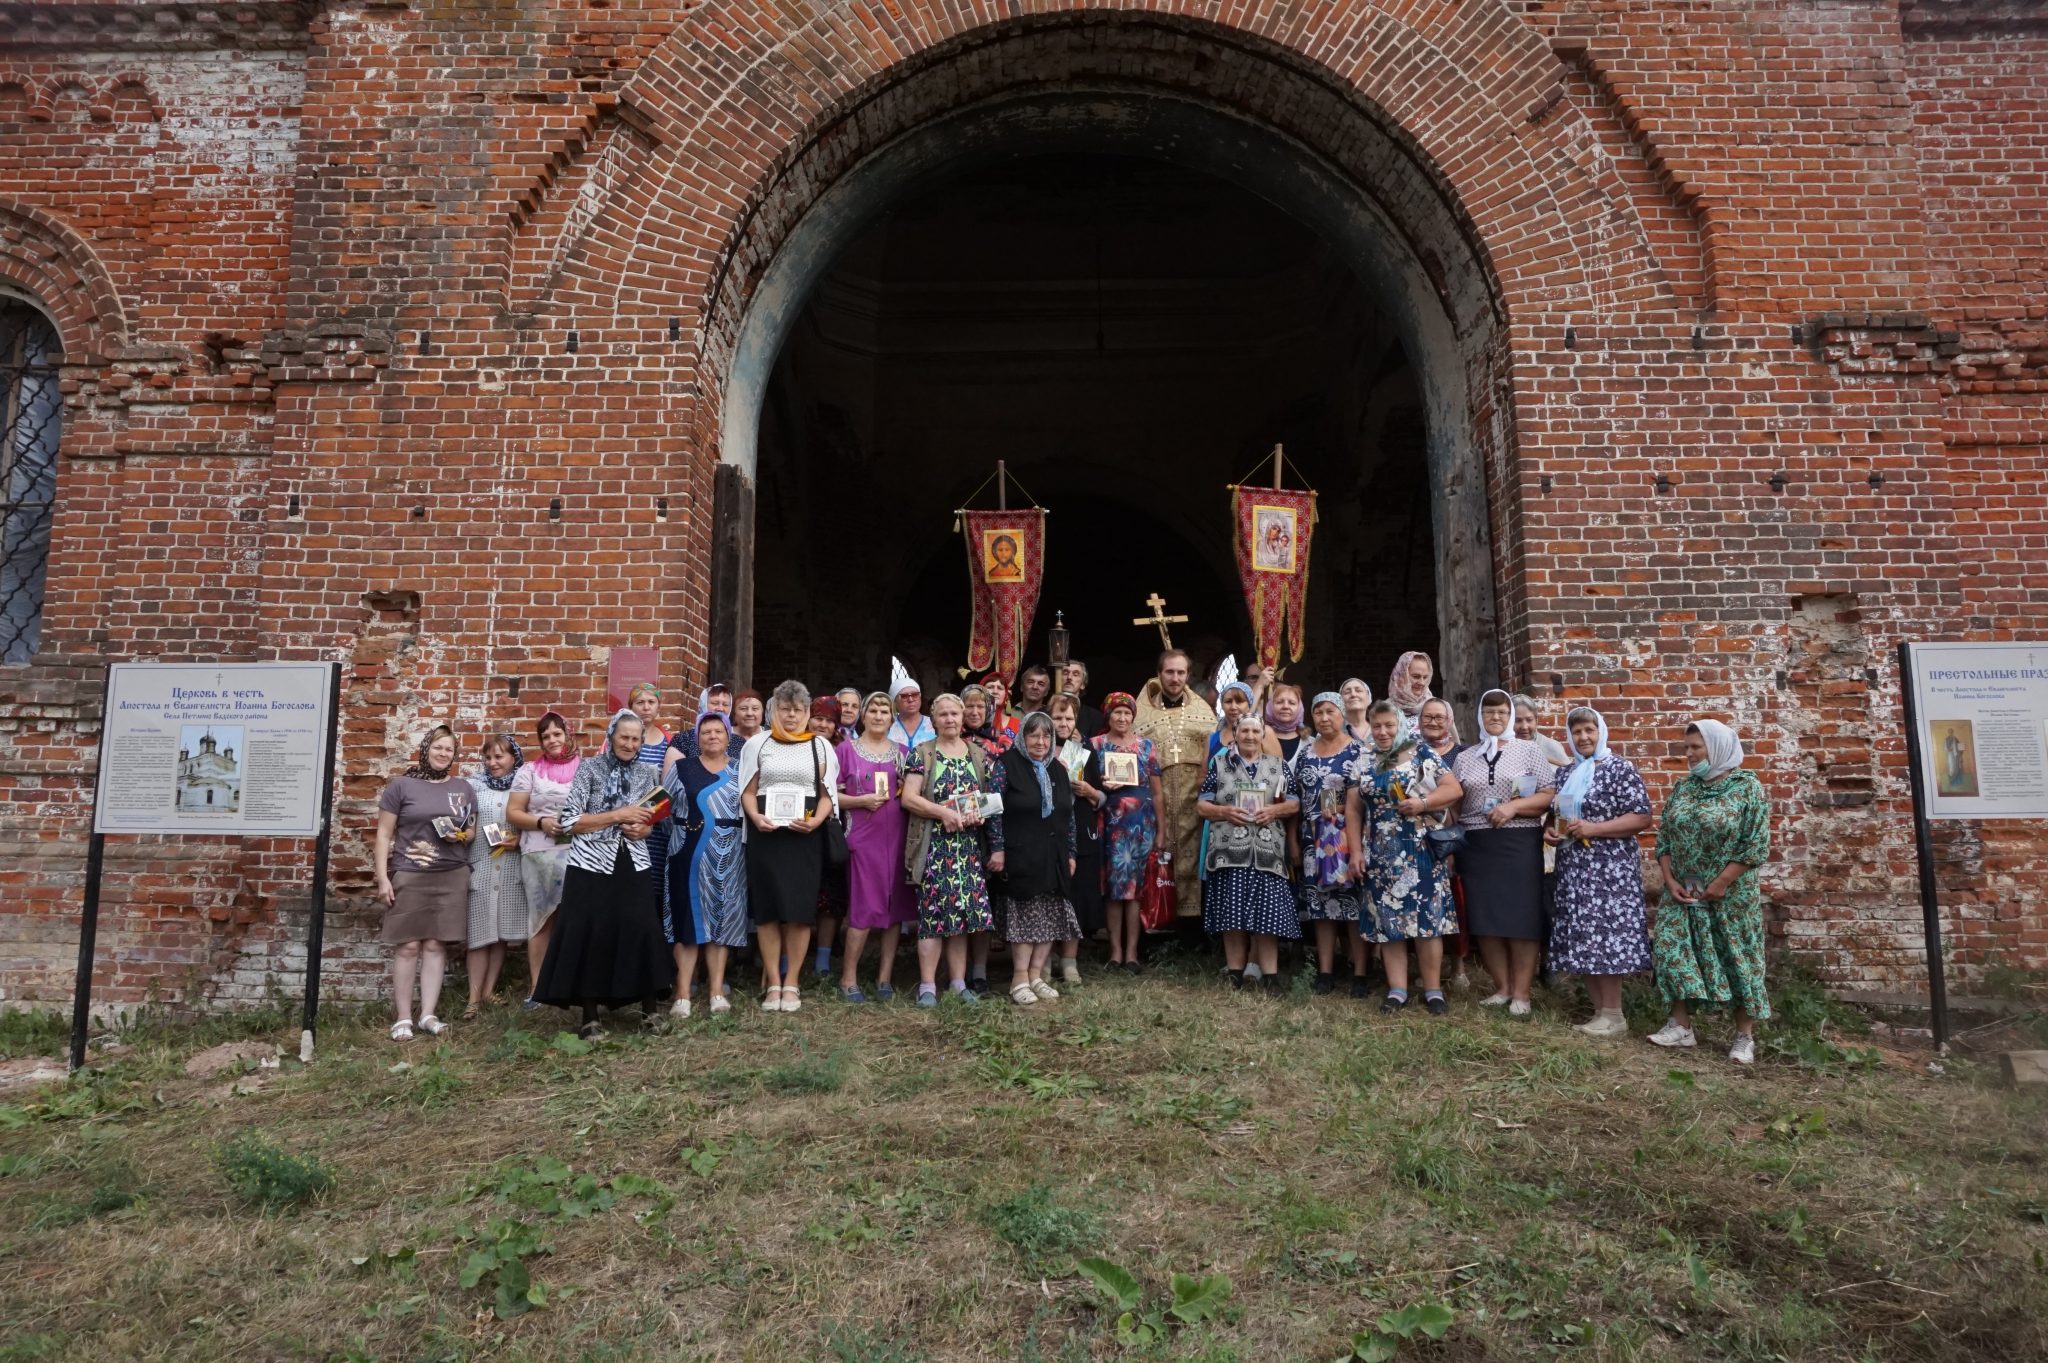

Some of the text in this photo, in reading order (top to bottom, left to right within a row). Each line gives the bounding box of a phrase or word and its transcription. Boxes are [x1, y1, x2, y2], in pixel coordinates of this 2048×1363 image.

[1929, 669, 2018, 680] ПРЕСТОЛЬНЫЕ
[172, 687, 265, 701] Церковь в честь
[119, 700, 161, 710] Апостола
[173, 700, 231, 710] Евангелиста
[235, 700, 268, 710] Иоанна
[271, 700, 315, 710] Богослова
